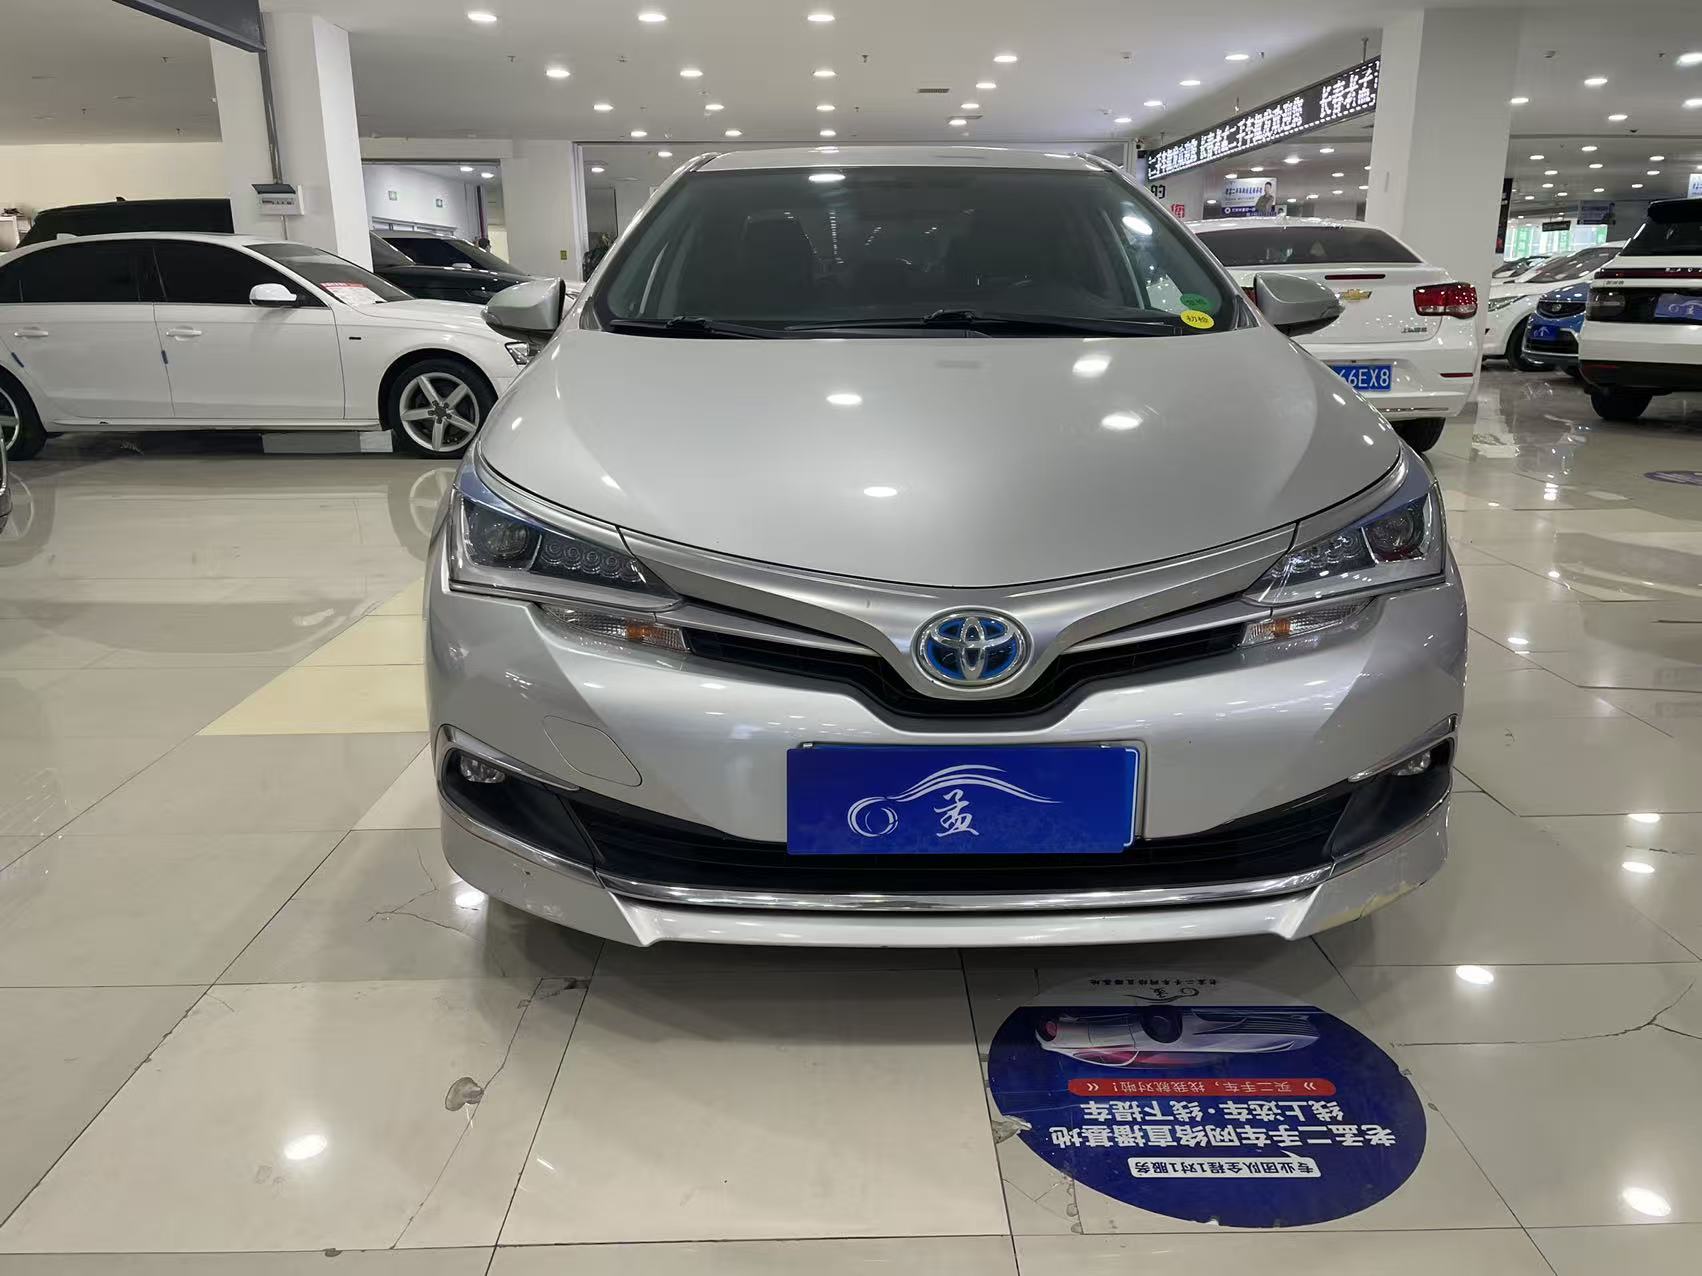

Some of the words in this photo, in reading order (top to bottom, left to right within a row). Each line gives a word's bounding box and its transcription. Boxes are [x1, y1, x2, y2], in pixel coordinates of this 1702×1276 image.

[1080, 1100, 1344, 1122] 线上选车·线下提车
[1049, 1124, 1396, 1149] 老孟二手车网络直播基地
[1134, 1161, 1316, 1175] 专业团队全程1对1服务
